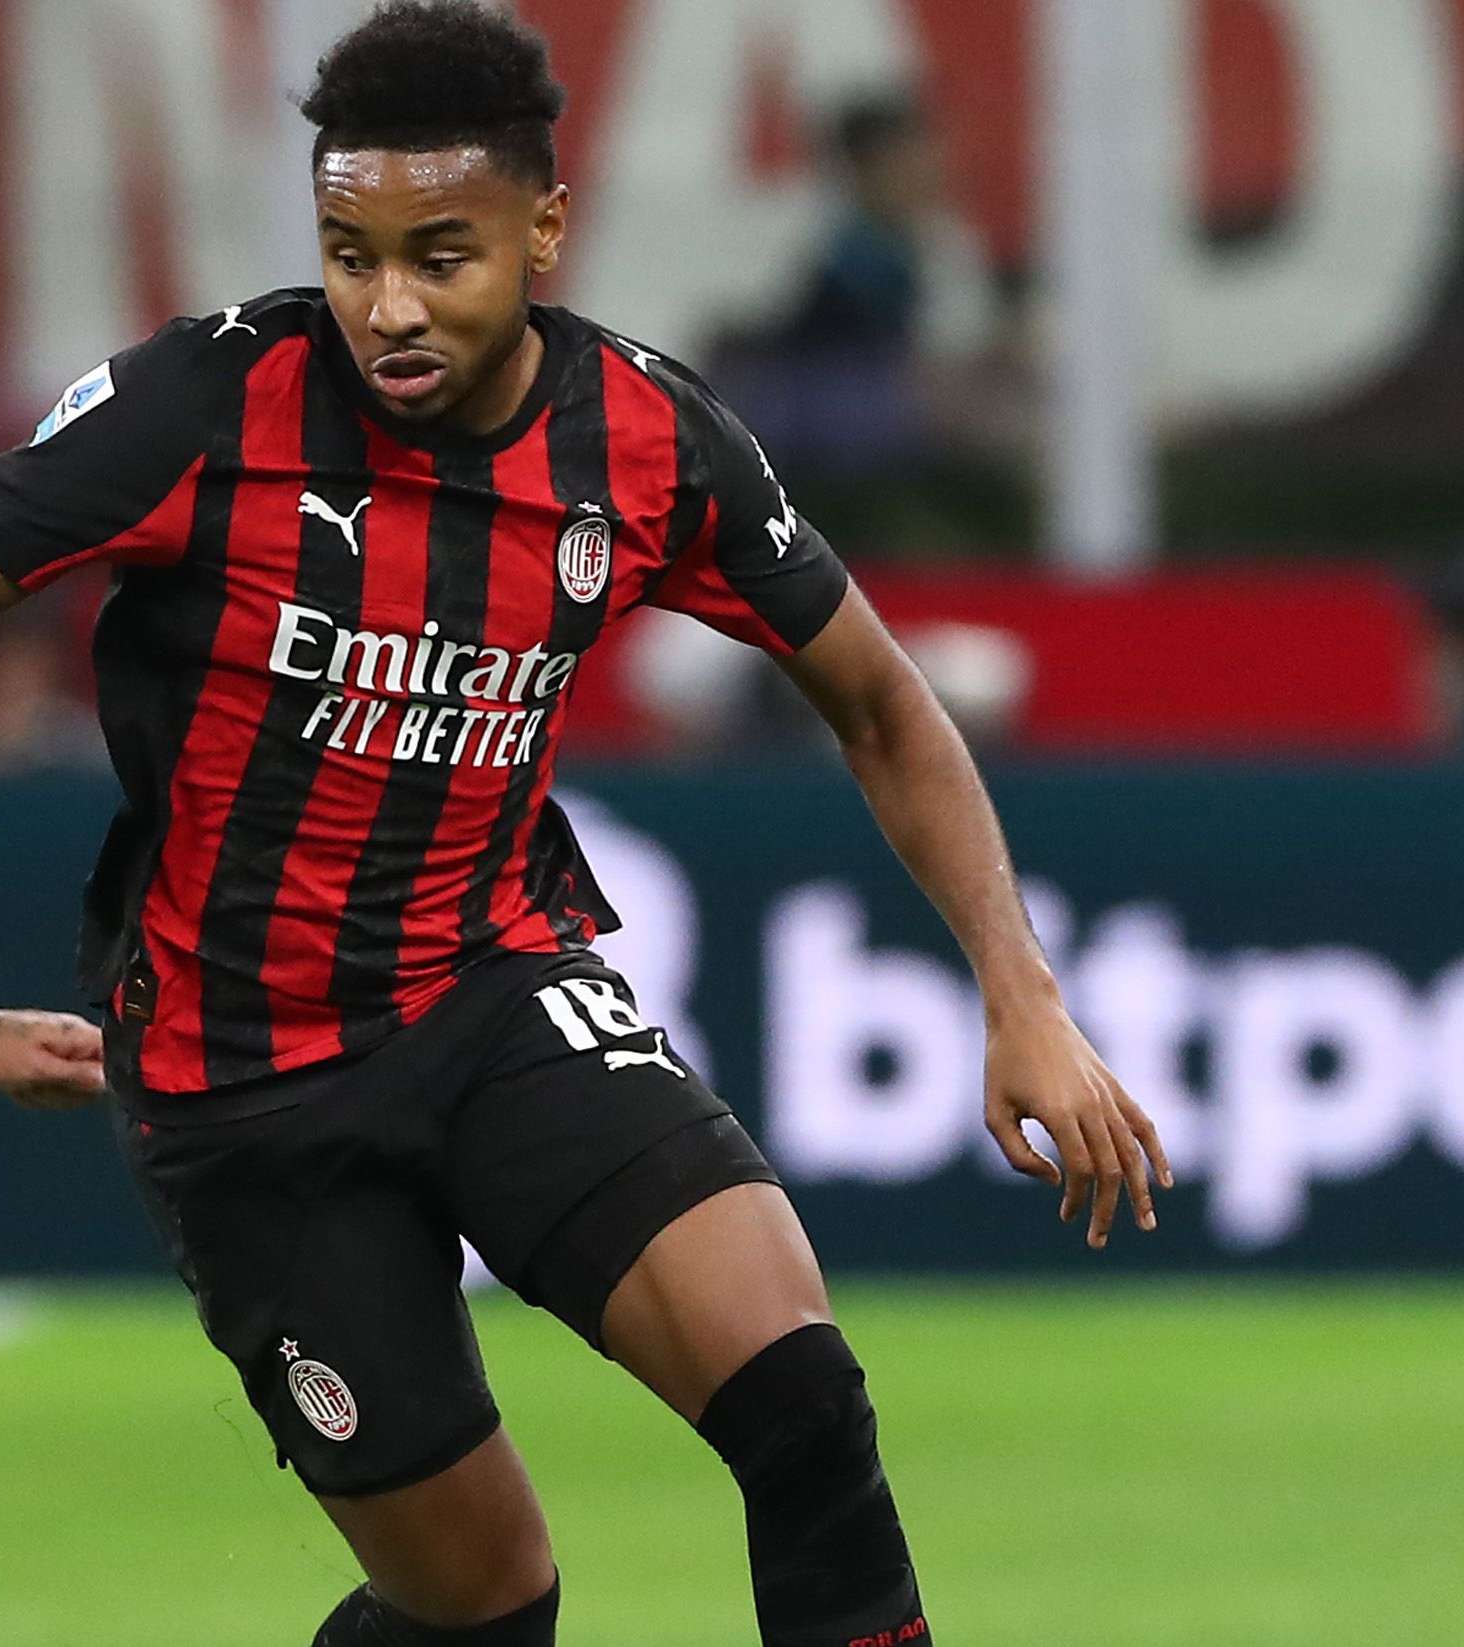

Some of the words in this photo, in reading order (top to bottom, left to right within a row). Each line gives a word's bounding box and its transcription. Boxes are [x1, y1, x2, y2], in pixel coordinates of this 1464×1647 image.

[269, 601, 578, 703] Emirate
[301, 691, 391, 755] FLY
[393, 703, 546, 768] BETTER
[533, 978, 648, 1051] 18
